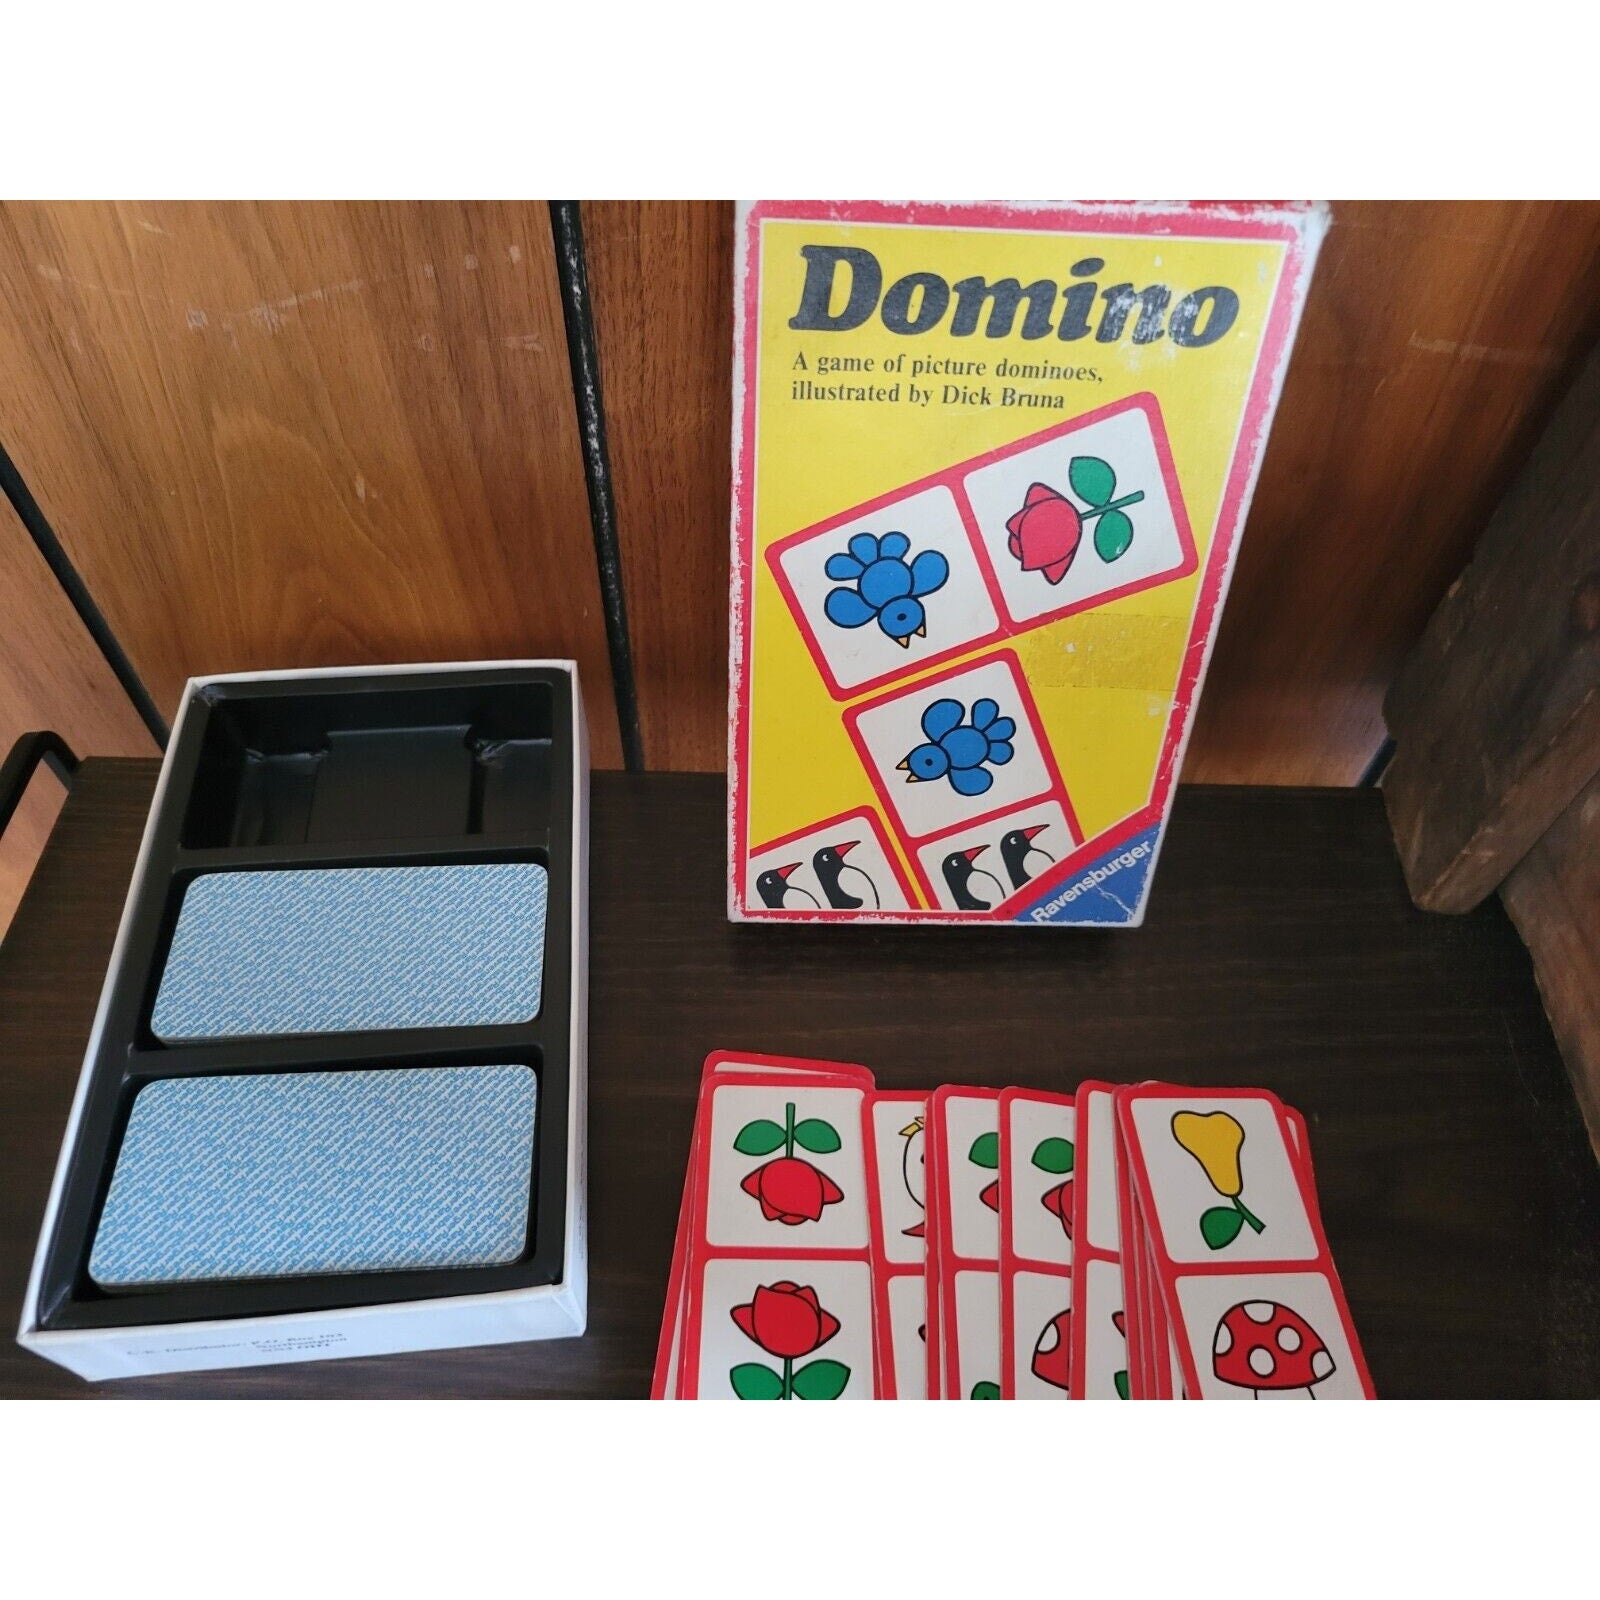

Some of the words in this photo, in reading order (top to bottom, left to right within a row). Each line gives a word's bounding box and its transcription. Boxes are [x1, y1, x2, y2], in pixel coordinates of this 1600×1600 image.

[788, 244, 1240, 348] Domino
[791, 380, 900, 402] illustrated
[908, 382, 934, 407] by
[942, 384, 992, 406] Dick
[1001, 388, 1065, 409] Bruna
[792, 355, 808, 371] A
[817, 357, 875, 377] game
[883, 353, 904, 373] of
[912, 357, 987, 379] picture
[995, 359, 1104, 384] dominoes,
[1030, 841, 1151, 922] Ravensburger
